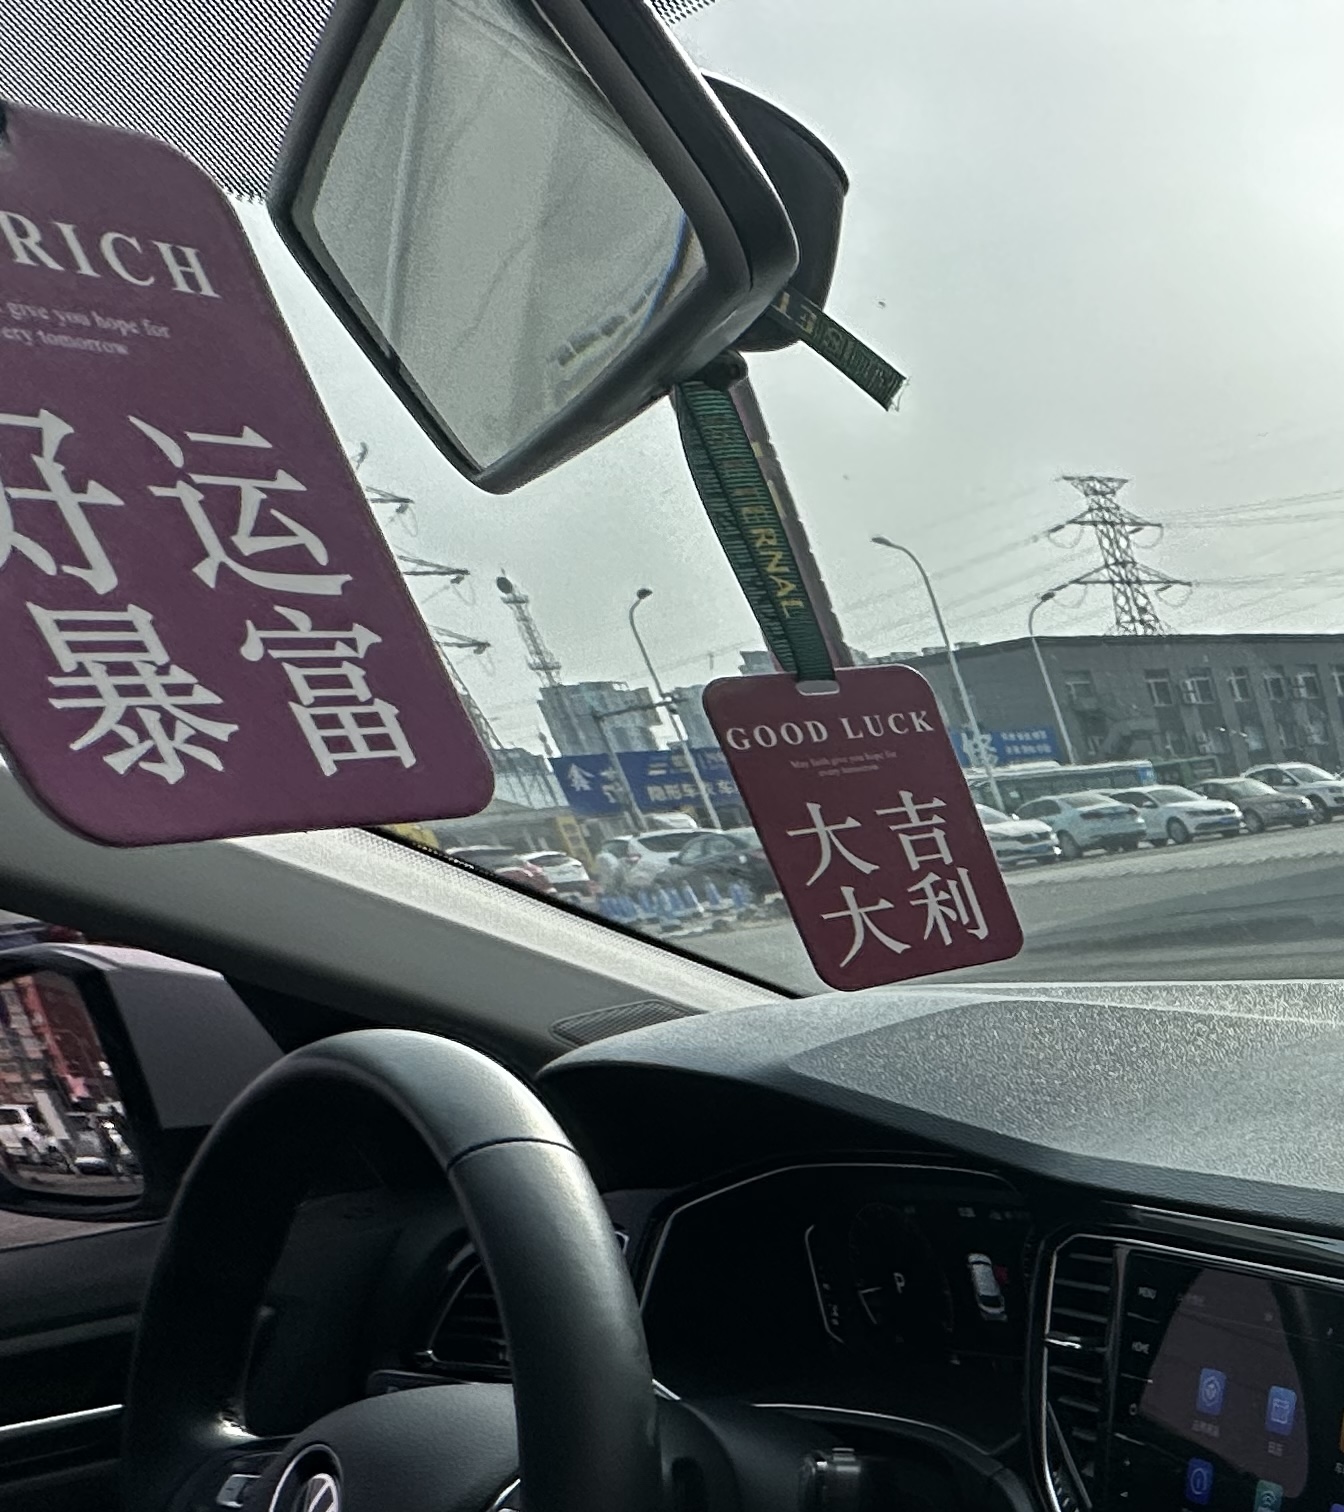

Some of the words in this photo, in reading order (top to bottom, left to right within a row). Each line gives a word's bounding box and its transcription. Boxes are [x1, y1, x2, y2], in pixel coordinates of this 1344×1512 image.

[0, 209, 223, 299] RICH
[6, 302, 51, 321] give
[51, 308, 92, 327] you
[91, 311, 141, 337] hope
[143, 319, 171, 339] for
[36, 330, 130, 355] tomorrow
[0, 408, 353, 596] 好运
[26, 601, 416, 785] 暴富
[726, 720, 829, 751] GOOD
[839, 710, 934, 739] LUCK
[787, 790, 956, 886] 大吉
[820, 866, 989, 969] 大利
